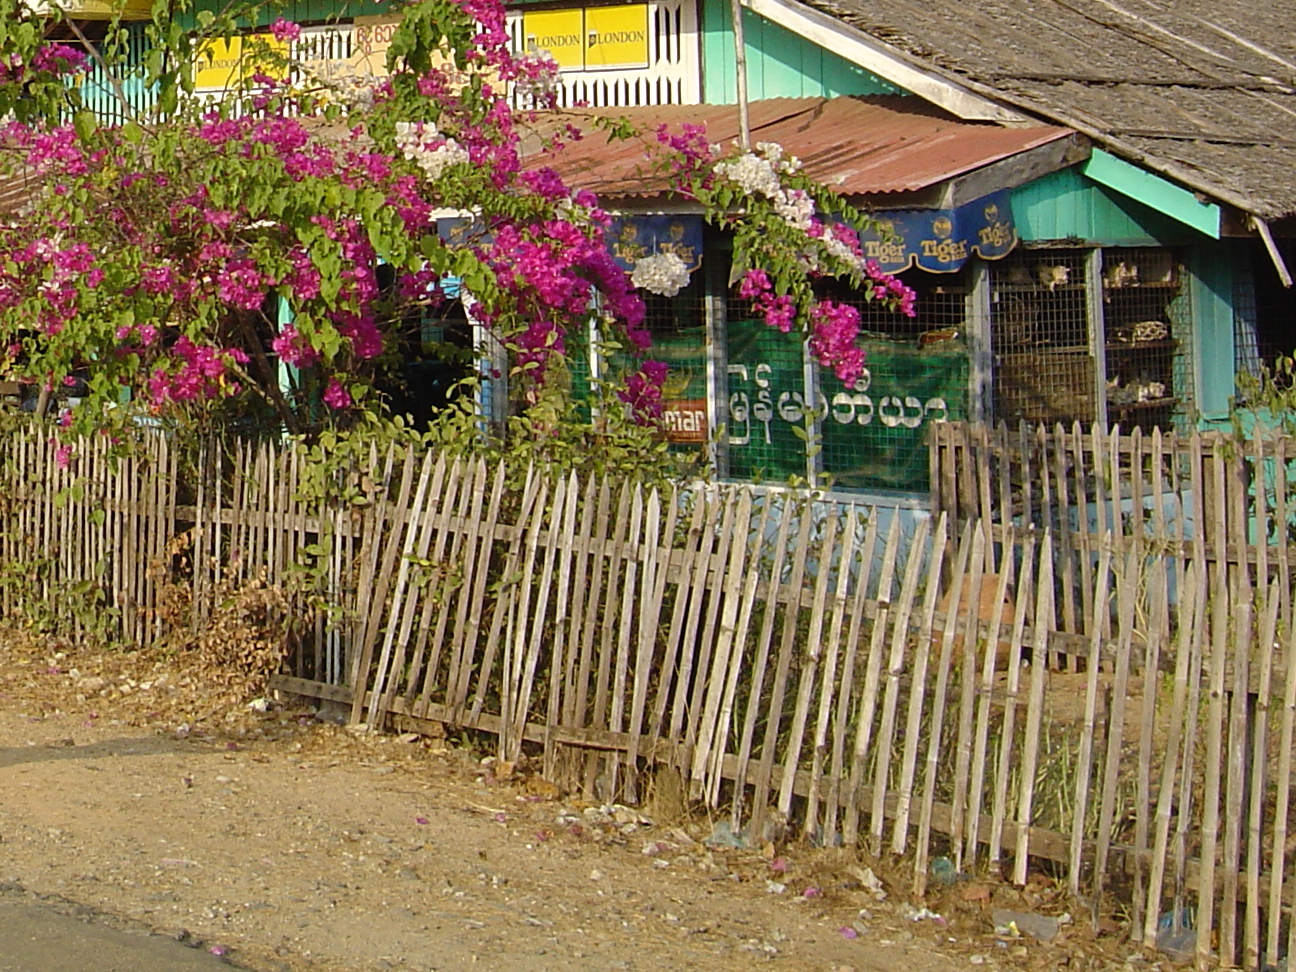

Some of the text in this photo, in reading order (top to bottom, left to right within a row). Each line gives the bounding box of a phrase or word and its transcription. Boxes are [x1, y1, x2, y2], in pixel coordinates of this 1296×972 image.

[536, 34, 581, 48] LONDON
[598, 31, 645, 45] LONDON
[979, 221, 1010, 247] Tiger
[865, 240, 906, 264] Tiger
[921, 238, 967, 263] Tiger
